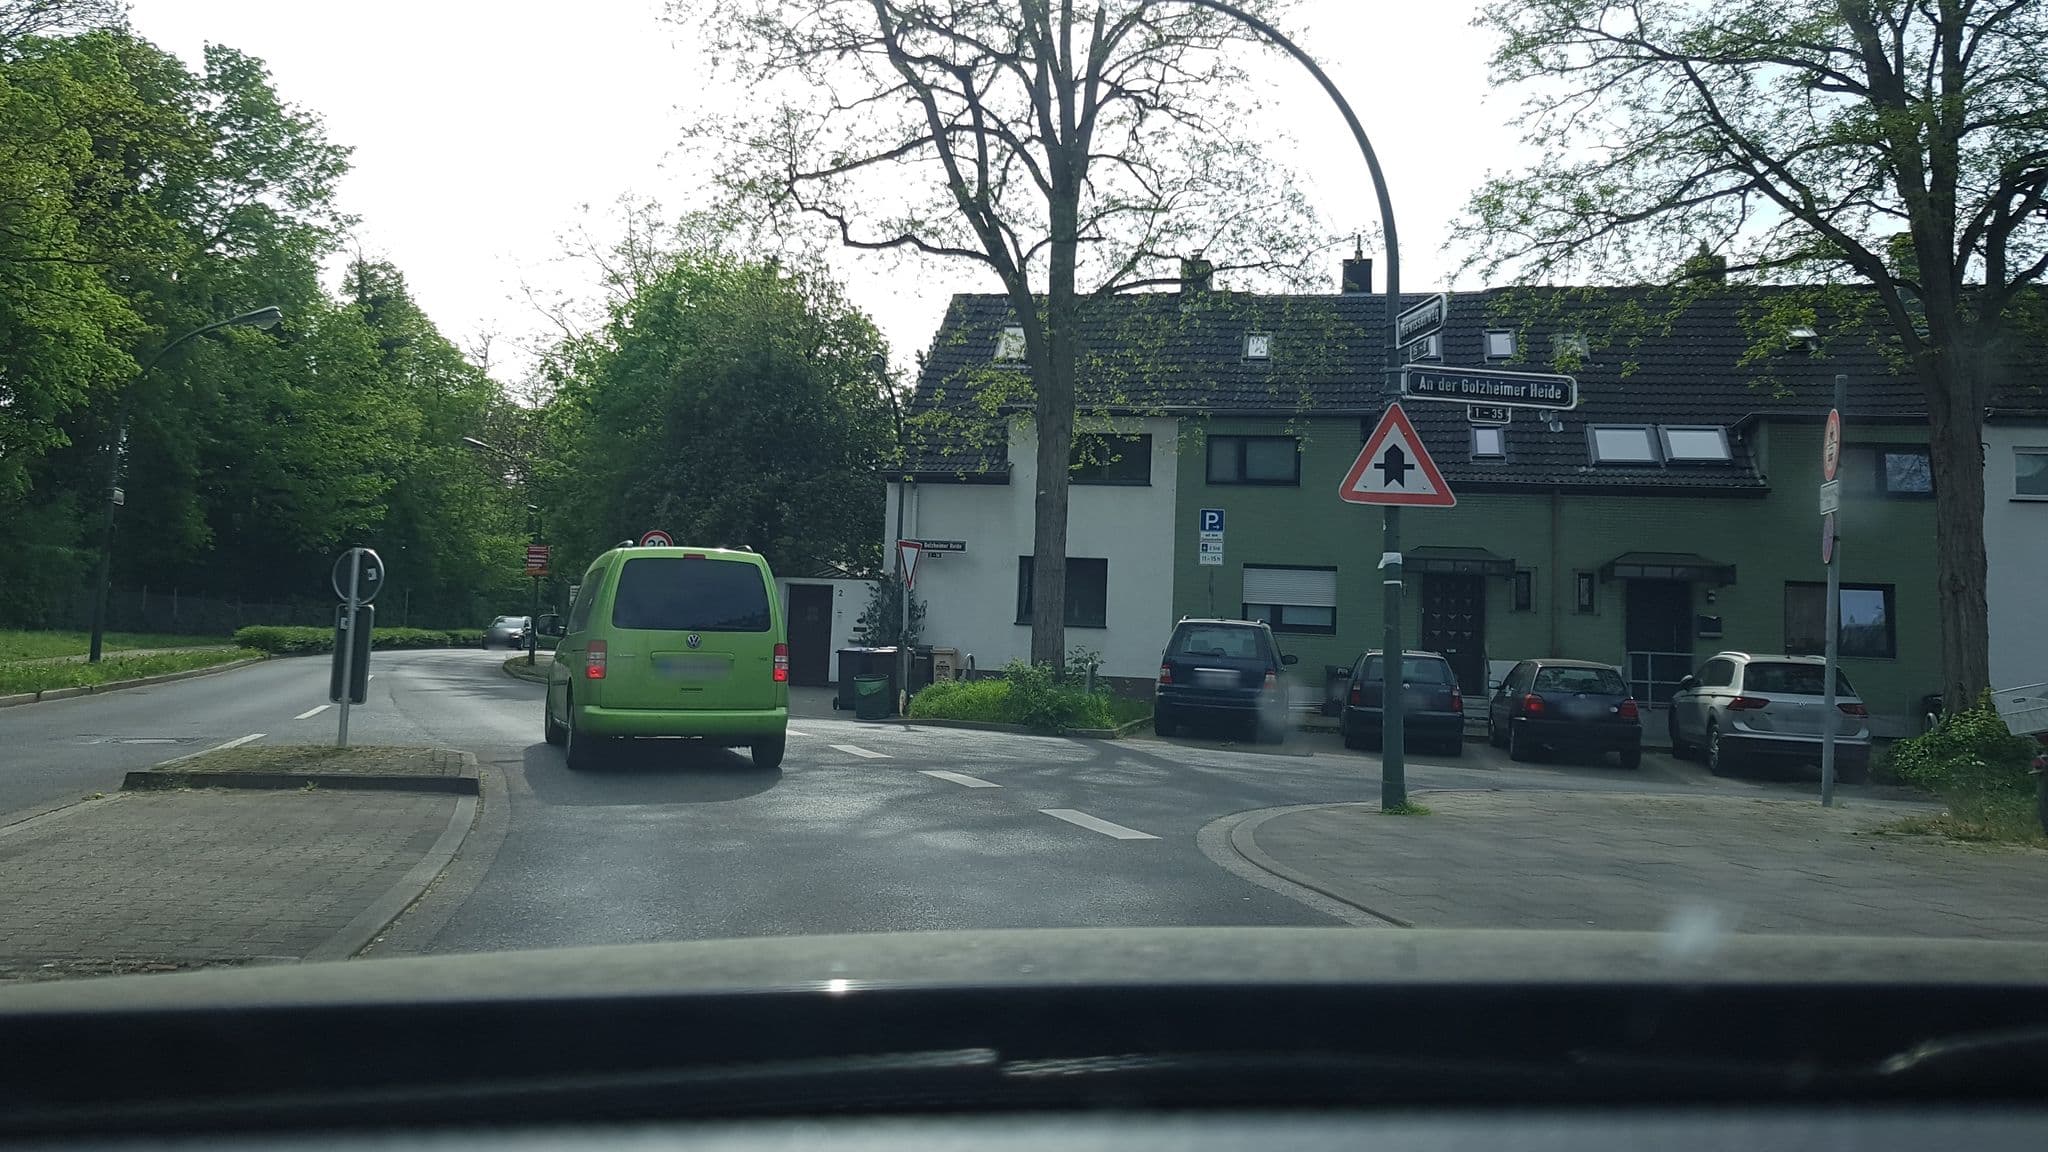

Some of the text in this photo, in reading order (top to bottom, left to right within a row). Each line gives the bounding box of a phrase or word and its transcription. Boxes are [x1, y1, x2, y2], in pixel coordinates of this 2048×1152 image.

[1419, 376, 1562, 399] An der Golzheimer Heide
[1491, 408, 1503, 419] 35
[1206, 512, 1219, 530] P
